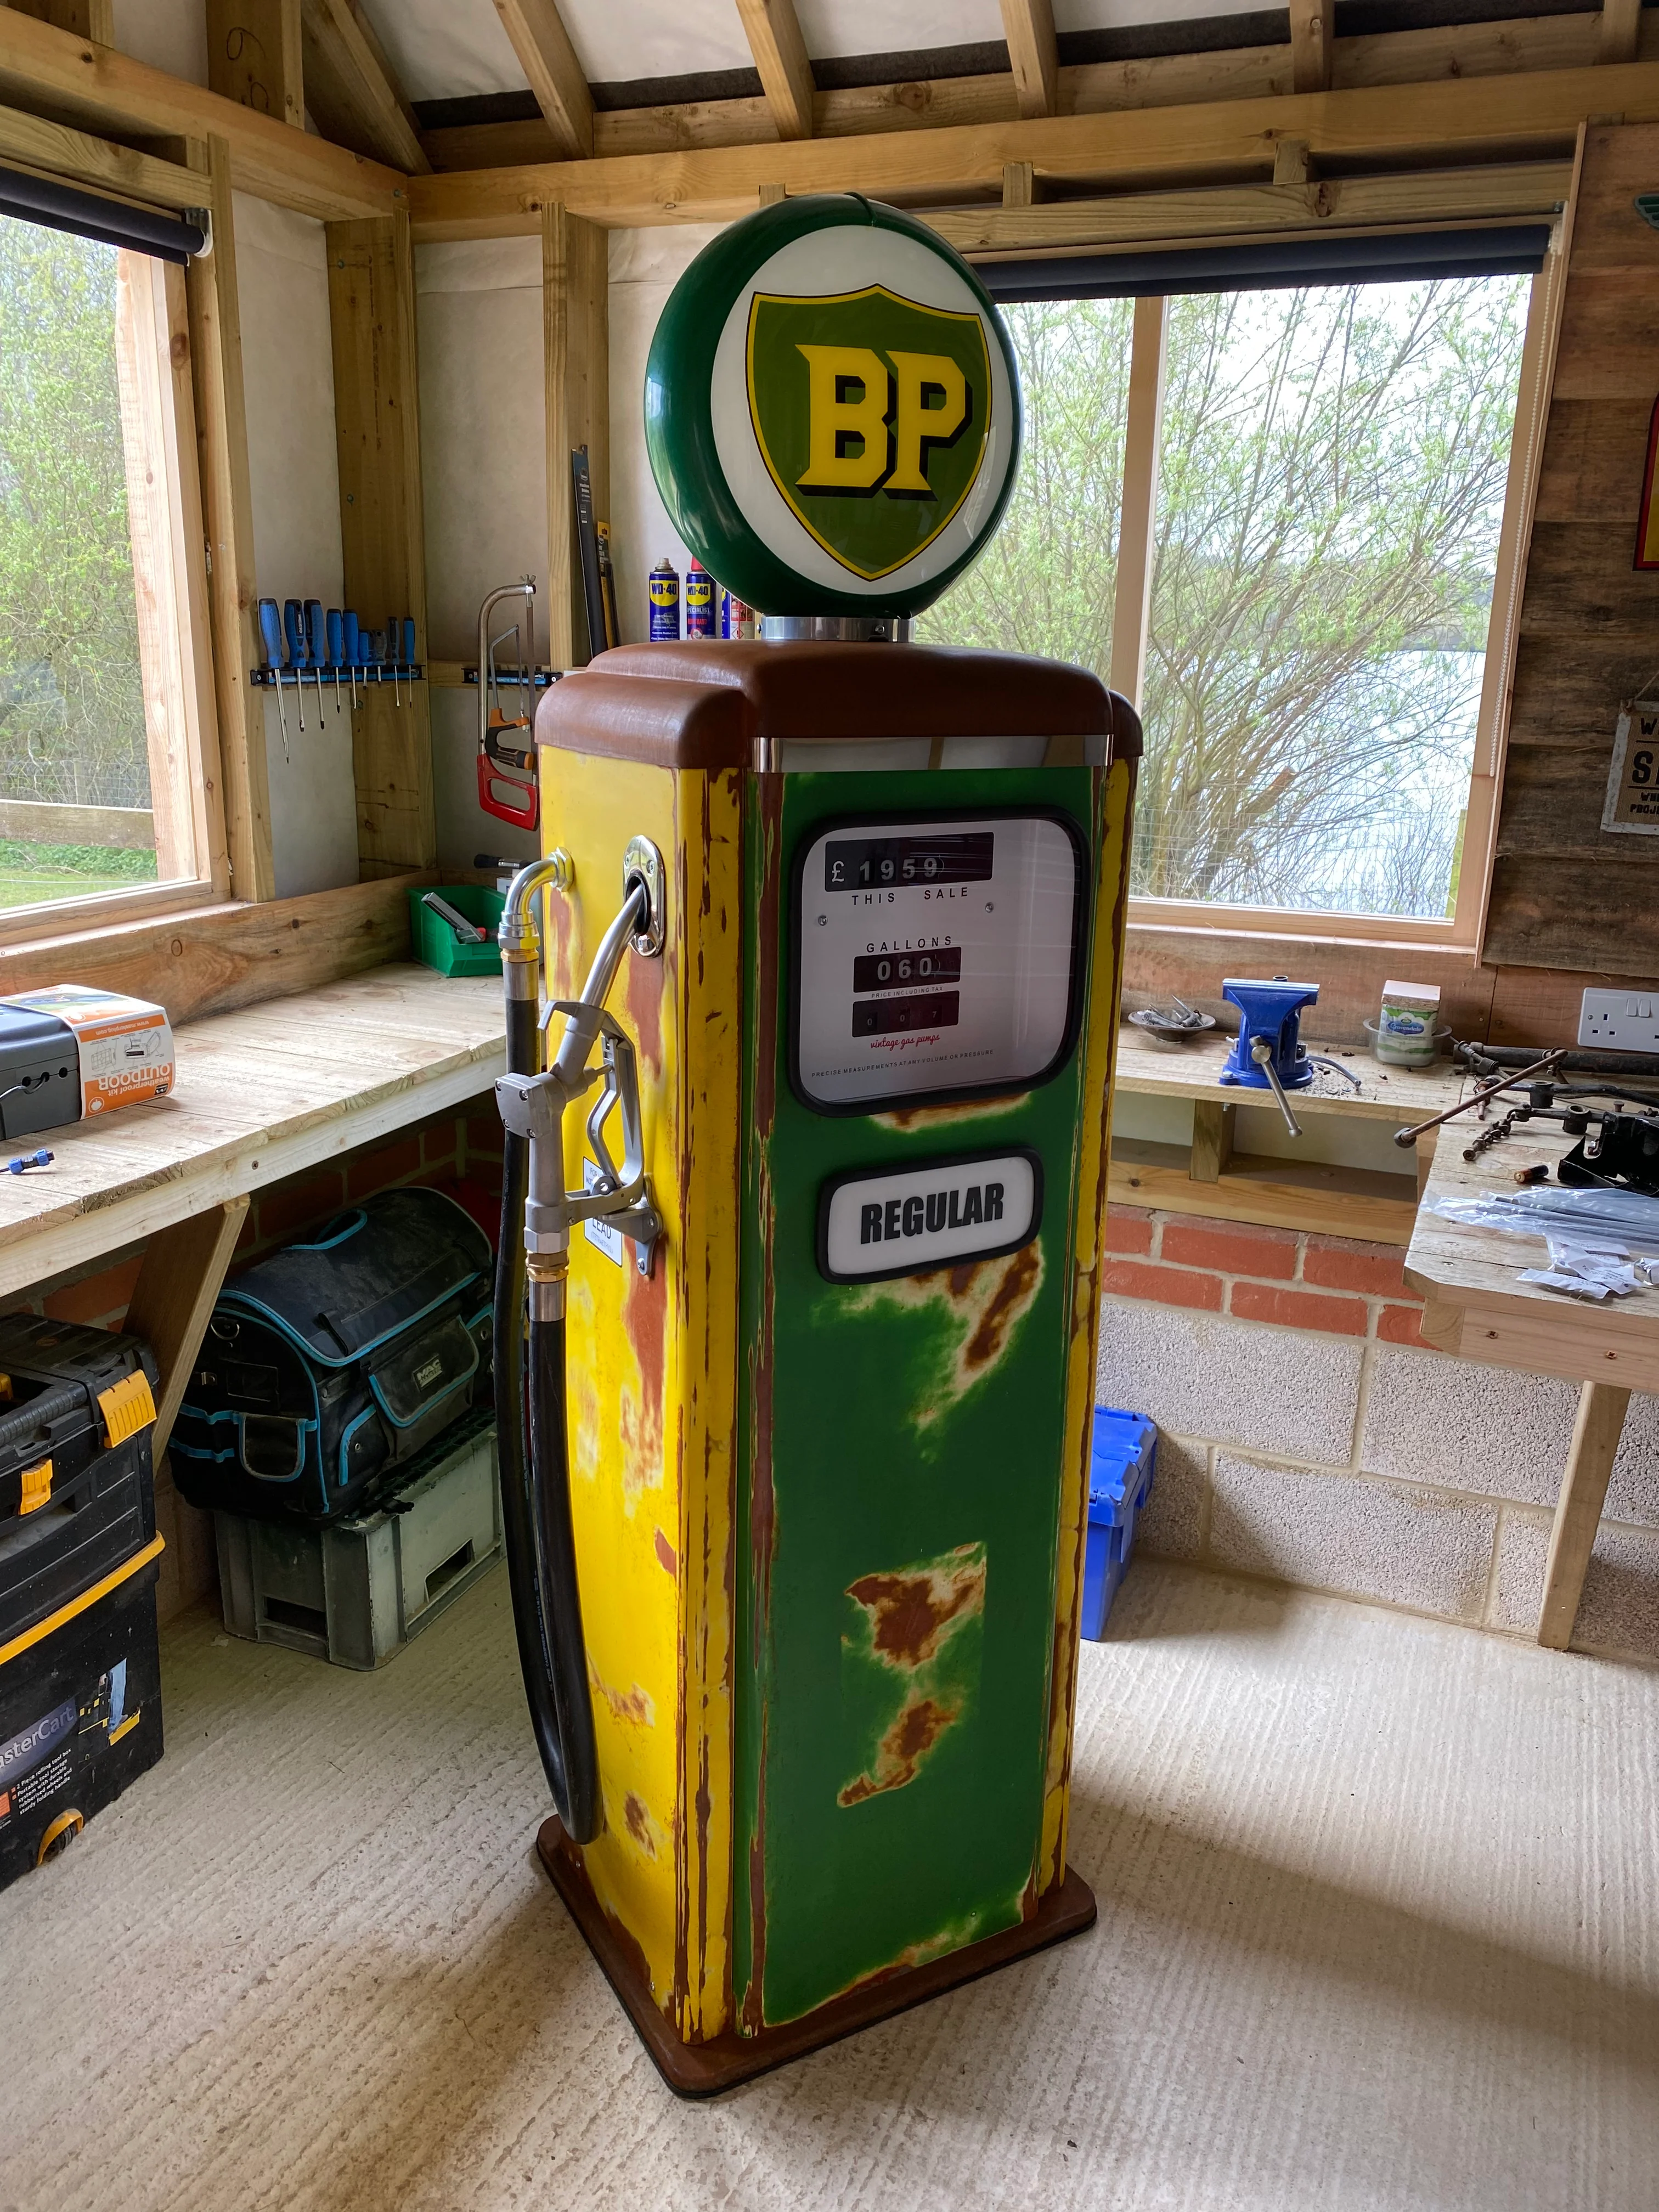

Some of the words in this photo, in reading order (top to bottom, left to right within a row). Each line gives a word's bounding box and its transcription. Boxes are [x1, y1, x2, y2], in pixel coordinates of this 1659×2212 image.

[794, 344, 973, 502] BP
[651, 583, 677, 595] WD-40
[832, 861, 844, 882] £
[860, 857, 937, 881] 1959
[851, 893, 895, 905] THIS
[924, 887, 968, 900] SALE
[867, 936, 951, 953] GALLONS
[877, 957, 932, 981] 060
[894, 988, 929, 996] INCLUDING
[95, 1020, 149, 1035] www.masterplug.com
[1390, 1022, 1423, 1031] Cravendale
[871, 1036, 900, 1051] vintage
[900, 1037, 915, 1050] gas
[916, 1034, 940, 1047] pumps
[811, 1069, 841, 1077] PRECISE
[844, 1062, 898, 1074] MEASUREMENTS
[960, 1049, 994, 1058] PRESSURE
[99, 1064, 170, 1091] OUTDOOR
[120, 1076, 170, 1094] weatherproof
[108, 1088, 118, 1096] kit
[860, 1183, 1005, 1245] REGULAR
[592, 1217, 611, 1239] LEAD
[17, 1779, 38, 1797] Portable
[39, 1771, 49, 1781] tool
[50, 1759, 67, 1774] storage
[21, 1774, 35, 1787] Piece
[36, 1763, 52, 1776] rolling
[52, 1754, 62, 1765] tool
[62, 1748, 71, 1757] box
[46, 1776, 63, 1790] wheels
[64, 1767, 72, 1778] and
[18, 1788, 37, 1803] system
[37, 1779, 48, 1790] with
[49, 1766, 67, 1781] durable
[19, 1801, 36, 1815] sturdy
[37, 1788, 54, 1803] folding
[54, 1775, 71, 1791] handle
